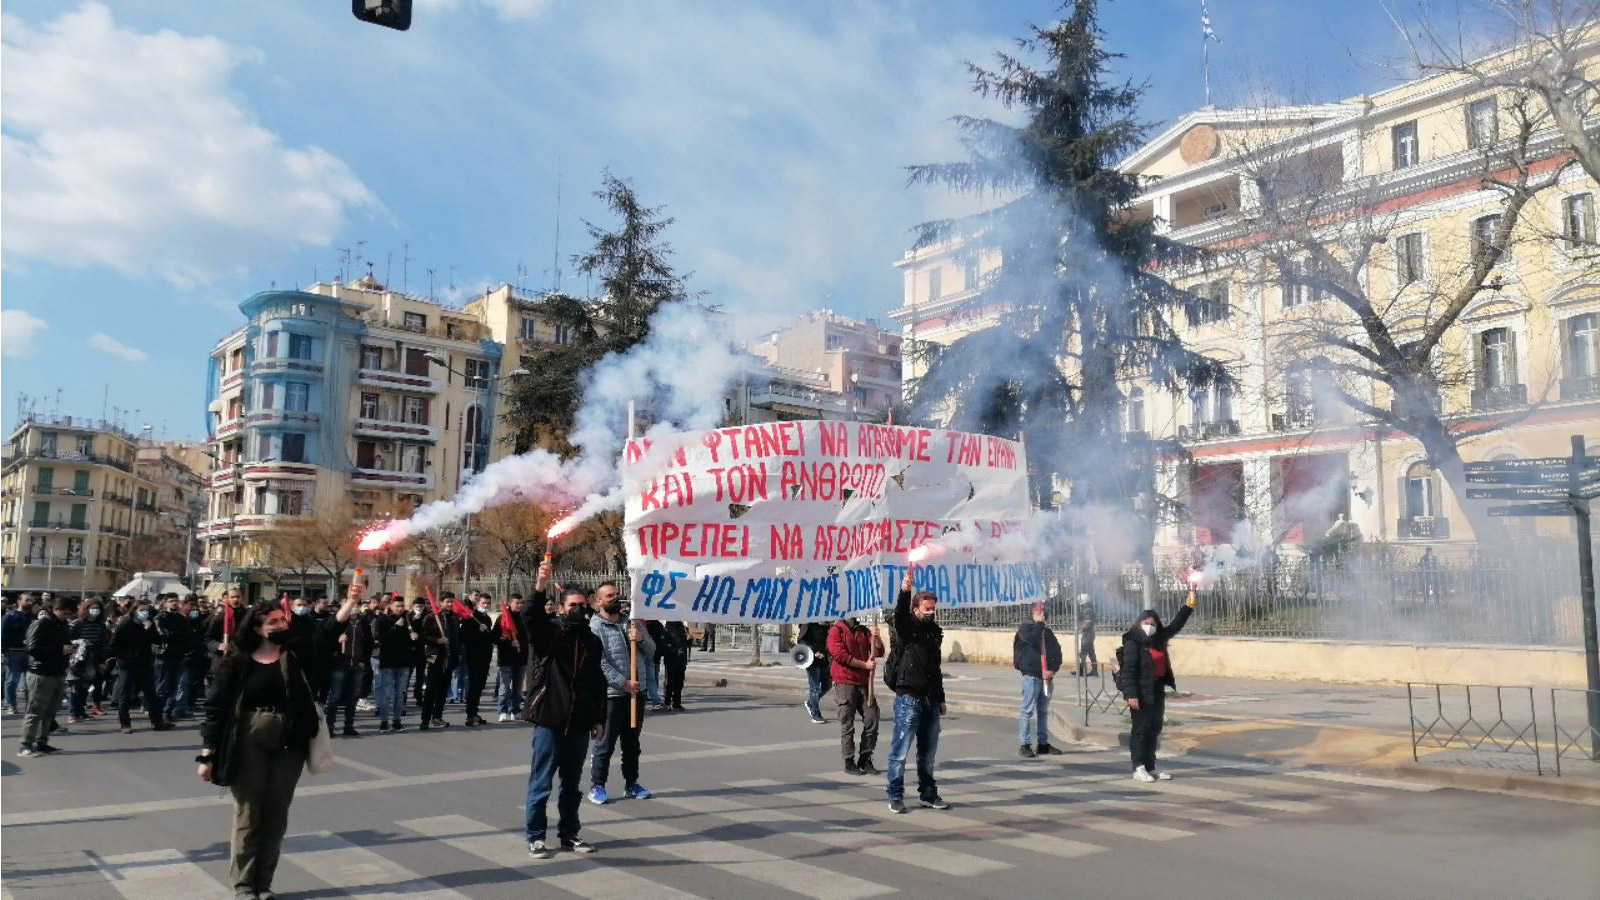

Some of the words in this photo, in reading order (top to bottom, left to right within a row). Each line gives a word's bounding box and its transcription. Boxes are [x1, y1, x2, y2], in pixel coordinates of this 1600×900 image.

[701, 421, 805, 463] ΦΤΑΝΕΙ
[819, 421, 848, 458] ΝΑ
[947, 431, 982, 467] ΤΗΝ
[641, 472, 694, 511] ΚΑΙ
[706, 462, 768, 503] ΤΟΝ
[638, 522, 750, 560] ΠΡΕΠΕΙ
[770, 523, 804, 560] ΝΑ
